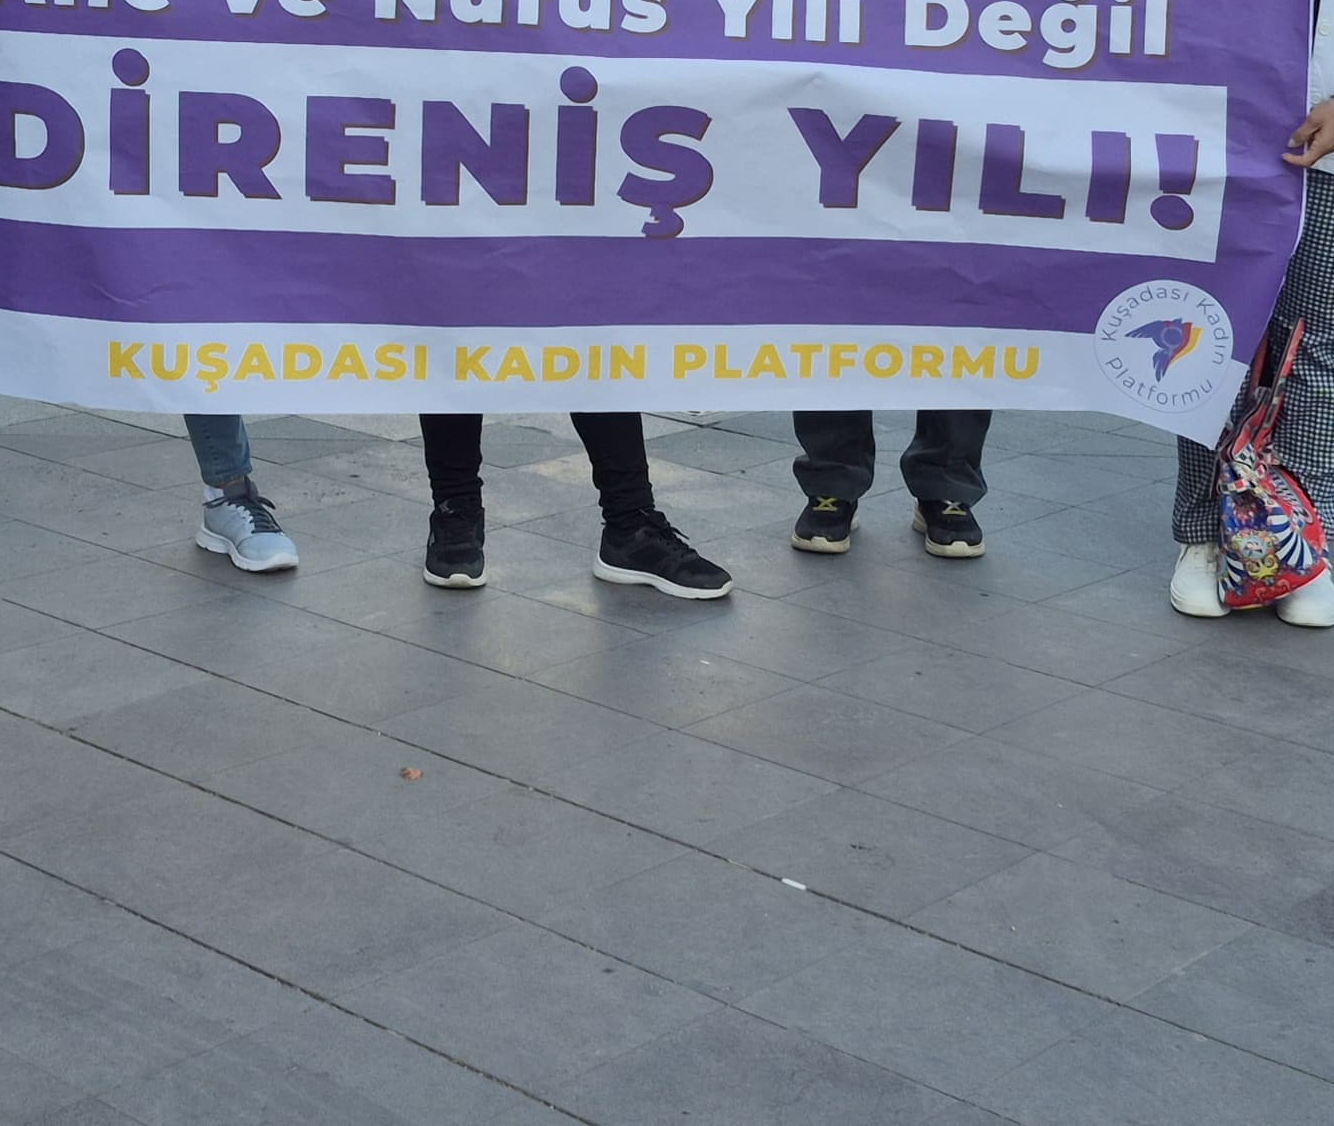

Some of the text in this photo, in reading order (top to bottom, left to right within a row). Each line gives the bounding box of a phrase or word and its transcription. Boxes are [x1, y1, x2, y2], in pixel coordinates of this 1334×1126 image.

[787, 106, 1200, 231] YILI!
[1100, 285, 1230, 365] Kuşadası Kadın
[108, 340, 1041, 393] KUŞADASI KADIN PLATFORMU
[1104, 356, 1214, 407] Platformu
